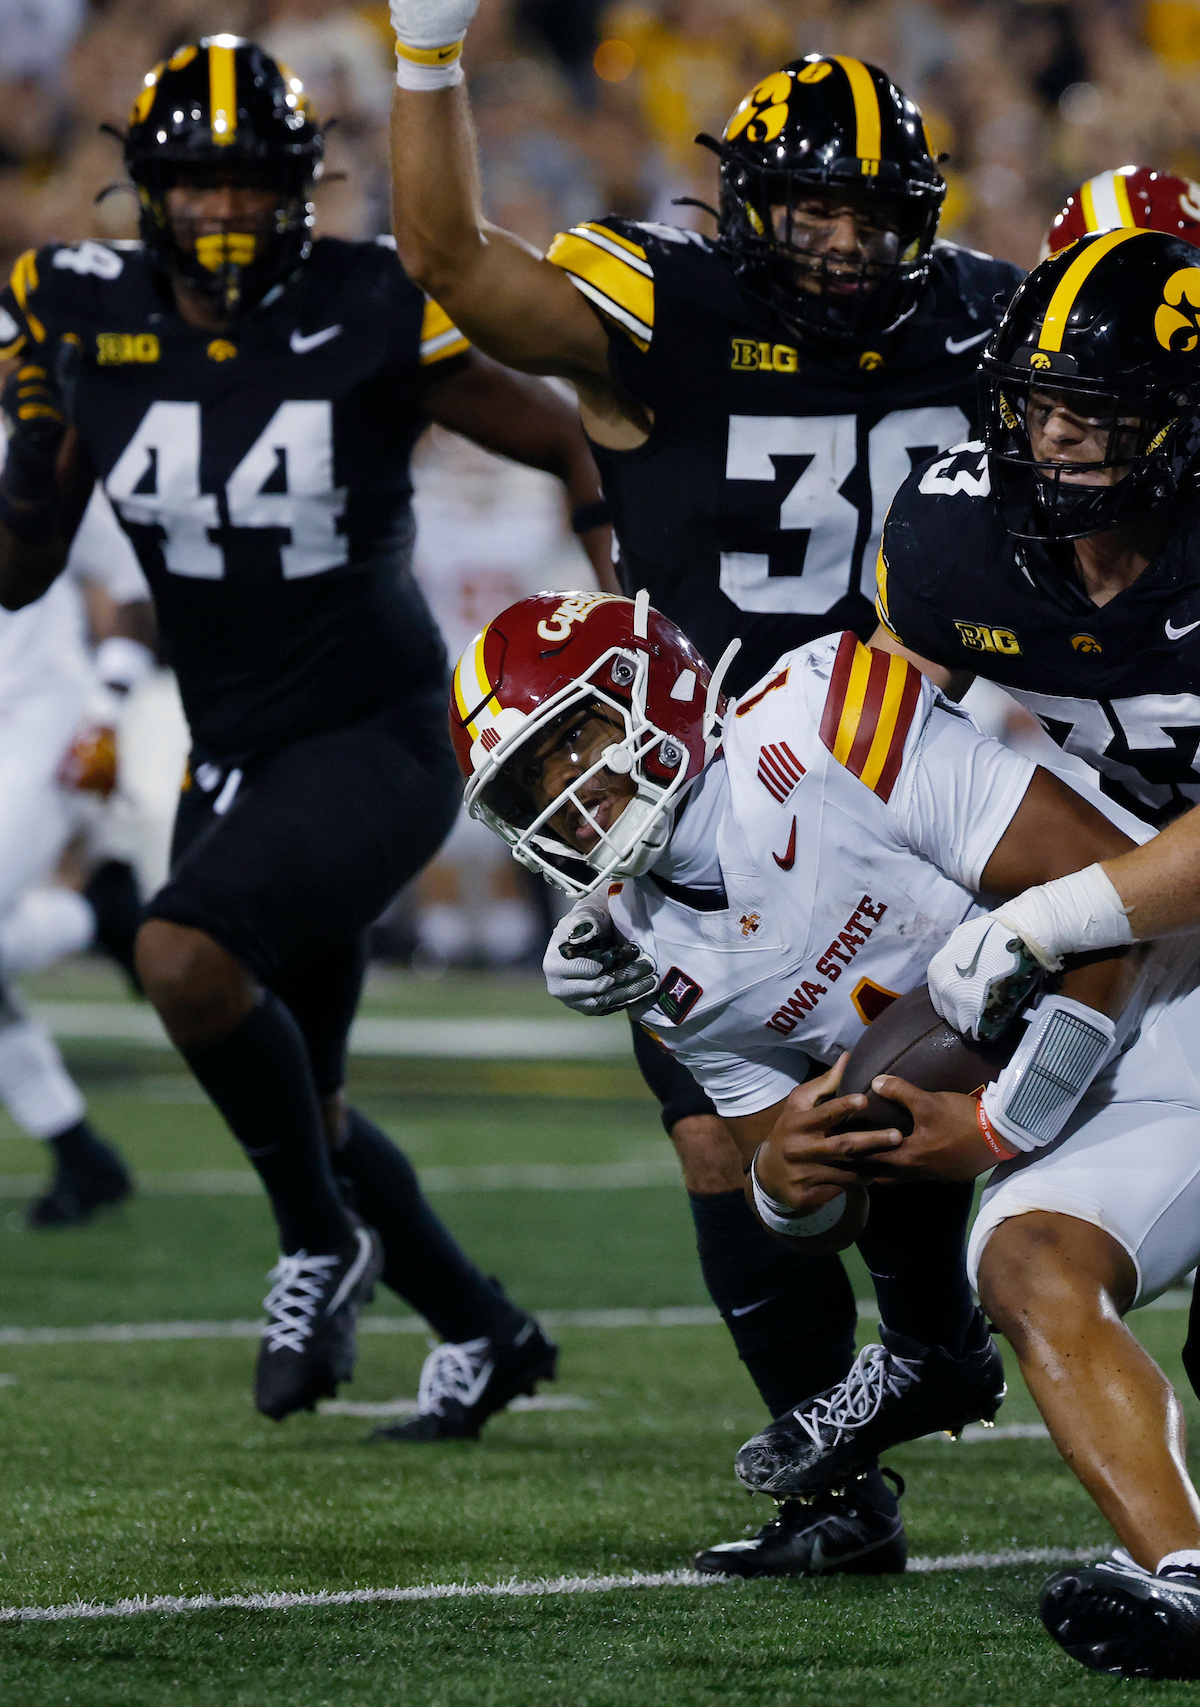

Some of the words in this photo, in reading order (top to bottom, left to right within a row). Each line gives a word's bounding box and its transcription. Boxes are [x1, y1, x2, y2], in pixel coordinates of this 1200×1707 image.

[105, 400, 349, 582] 44
[765, 980, 828, 1036] IOWA
[815, 894, 888, 983] STATE
